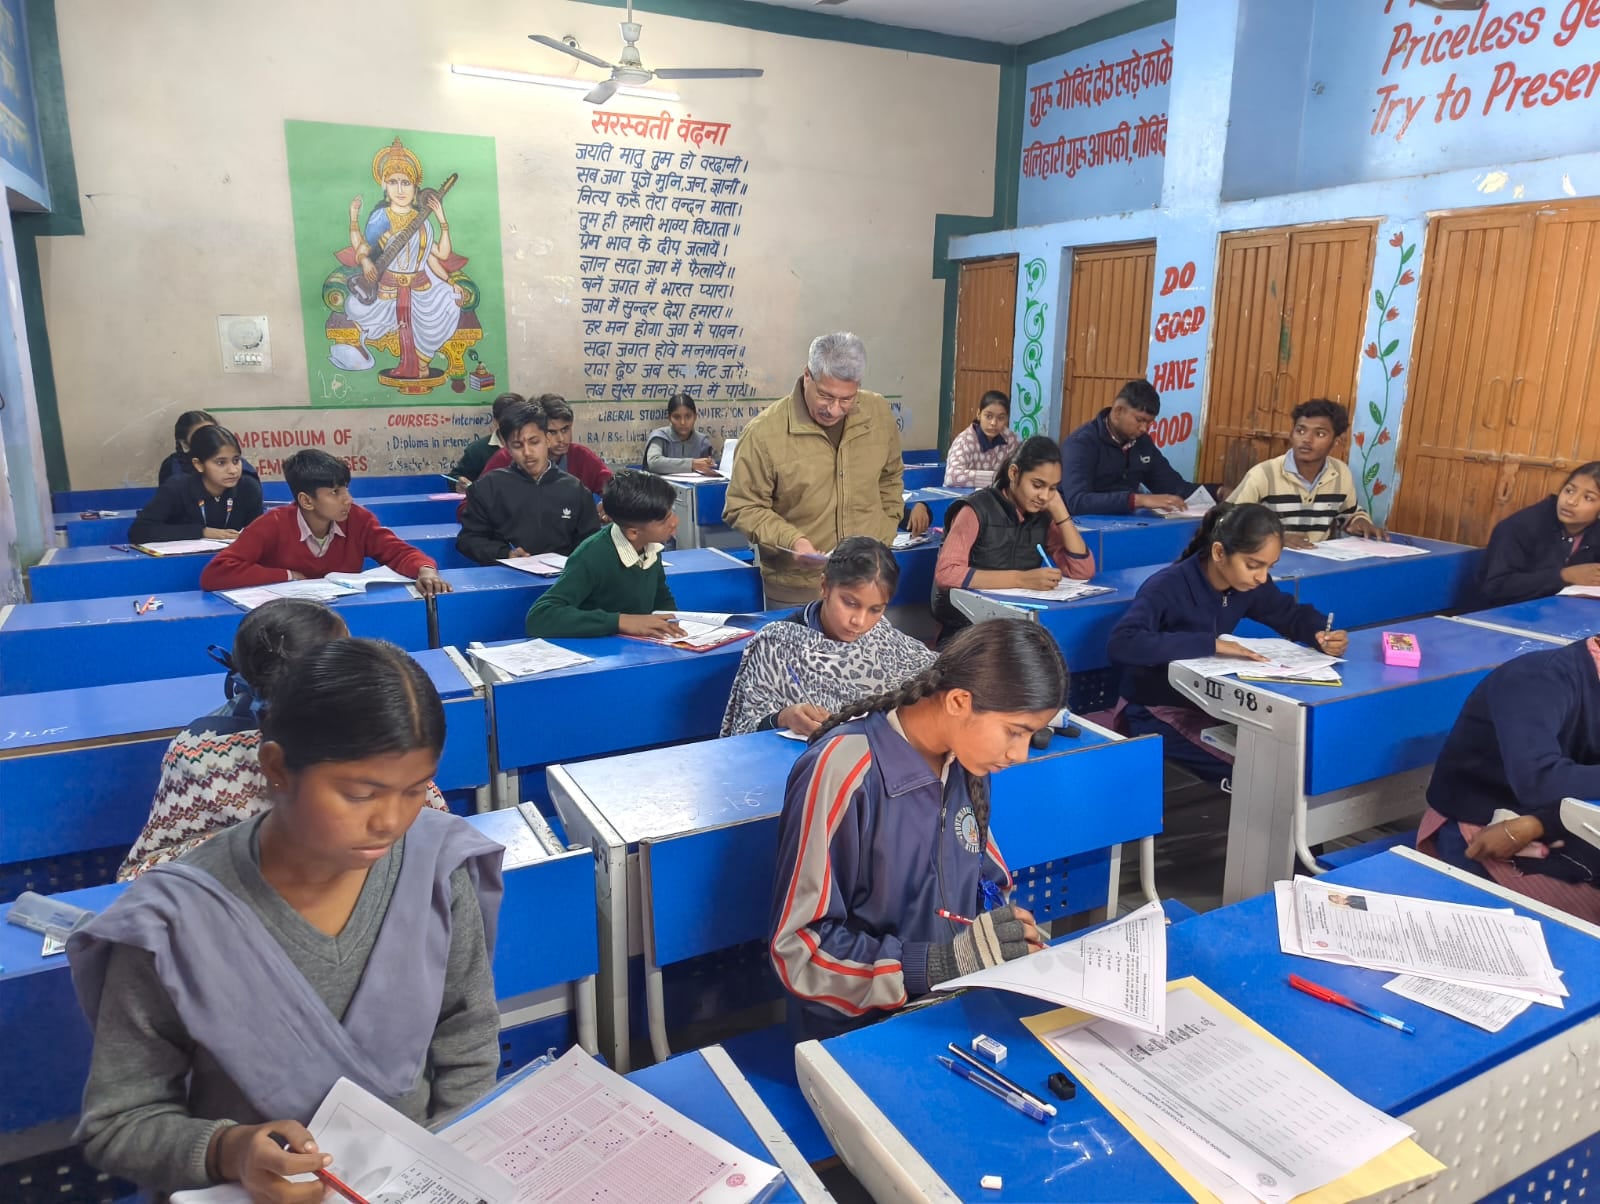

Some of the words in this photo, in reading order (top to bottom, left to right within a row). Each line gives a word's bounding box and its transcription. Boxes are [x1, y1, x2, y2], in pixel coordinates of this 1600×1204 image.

[1381, 1, 1546, 76] Priceless
[1371, 84, 1426, 141] Try
[1433, 73, 1471, 124] to
[592, 110, 674, 140] सरस्वती
[677, 113, 731, 149] वंदना
[575, 142, 614, 162] जयति
[619, 147, 646, 168] मातु
[651, 151, 675, 170] तुम
[680, 150, 696, 170] हो
[1022, 135, 1066, 181] बलिहारी
[576, 167, 600, 183] सब
[600, 169, 626, 185] जग
[631, 169, 653, 190] पूजे
[577, 185, 611, 206] नित्य
[645, 192, 668, 211] तेरा
[671, 197, 706, 217] वन्दन
[578, 211, 600, 230] तुम
[602, 210, 617, 231] ही
[622, 213, 655, 233] हमारी
[579, 231, 602, 249] प्रेम
[606, 236, 632, 251] भाव
[638, 234, 652, 252] के
[657, 236, 681, 255] दीप
[579, 255, 611, 273] ज्ञान
[614, 258, 642, 275] सदा
[644, 260, 667, 275] जग
[671, 258, 682, 276] में
[608, 279, 640, 295] जगत
[645, 277, 657, 295] में
[661, 282, 694, 297] भारत
[1160, 261, 1196, 296] DO
[582, 298, 606, 314] जग
[608, 297, 620, 314] में
[622, 301, 659, 319] सुन्दर
[663, 299, 686, 319] देश
[583, 320, 602, 335] हर
[605, 321, 629, 336] मन
[634, 319, 664, 338] होगा
[666, 323, 690, 337] जग
[693, 320, 704, 338] में
[1154, 305, 1206, 343] GOOD
[584, 341, 612, 359] सदा
[616, 342, 651, 358] जगत
[655, 340, 679, 360] होवे
[641, 364, 664, 378] जब
[1153, 357, 1198, 393] HAVE
[612, 383, 637, 402] सुख
[707, 382, 721, 398] में
[640, 409, 669, 420] STUDIE
[233, 430, 326, 448] MPENDIUM
[333, 429, 352, 446] OF
[1148, 411, 1193, 449] GOOD
[1234, 688, 1258, 711] 98
